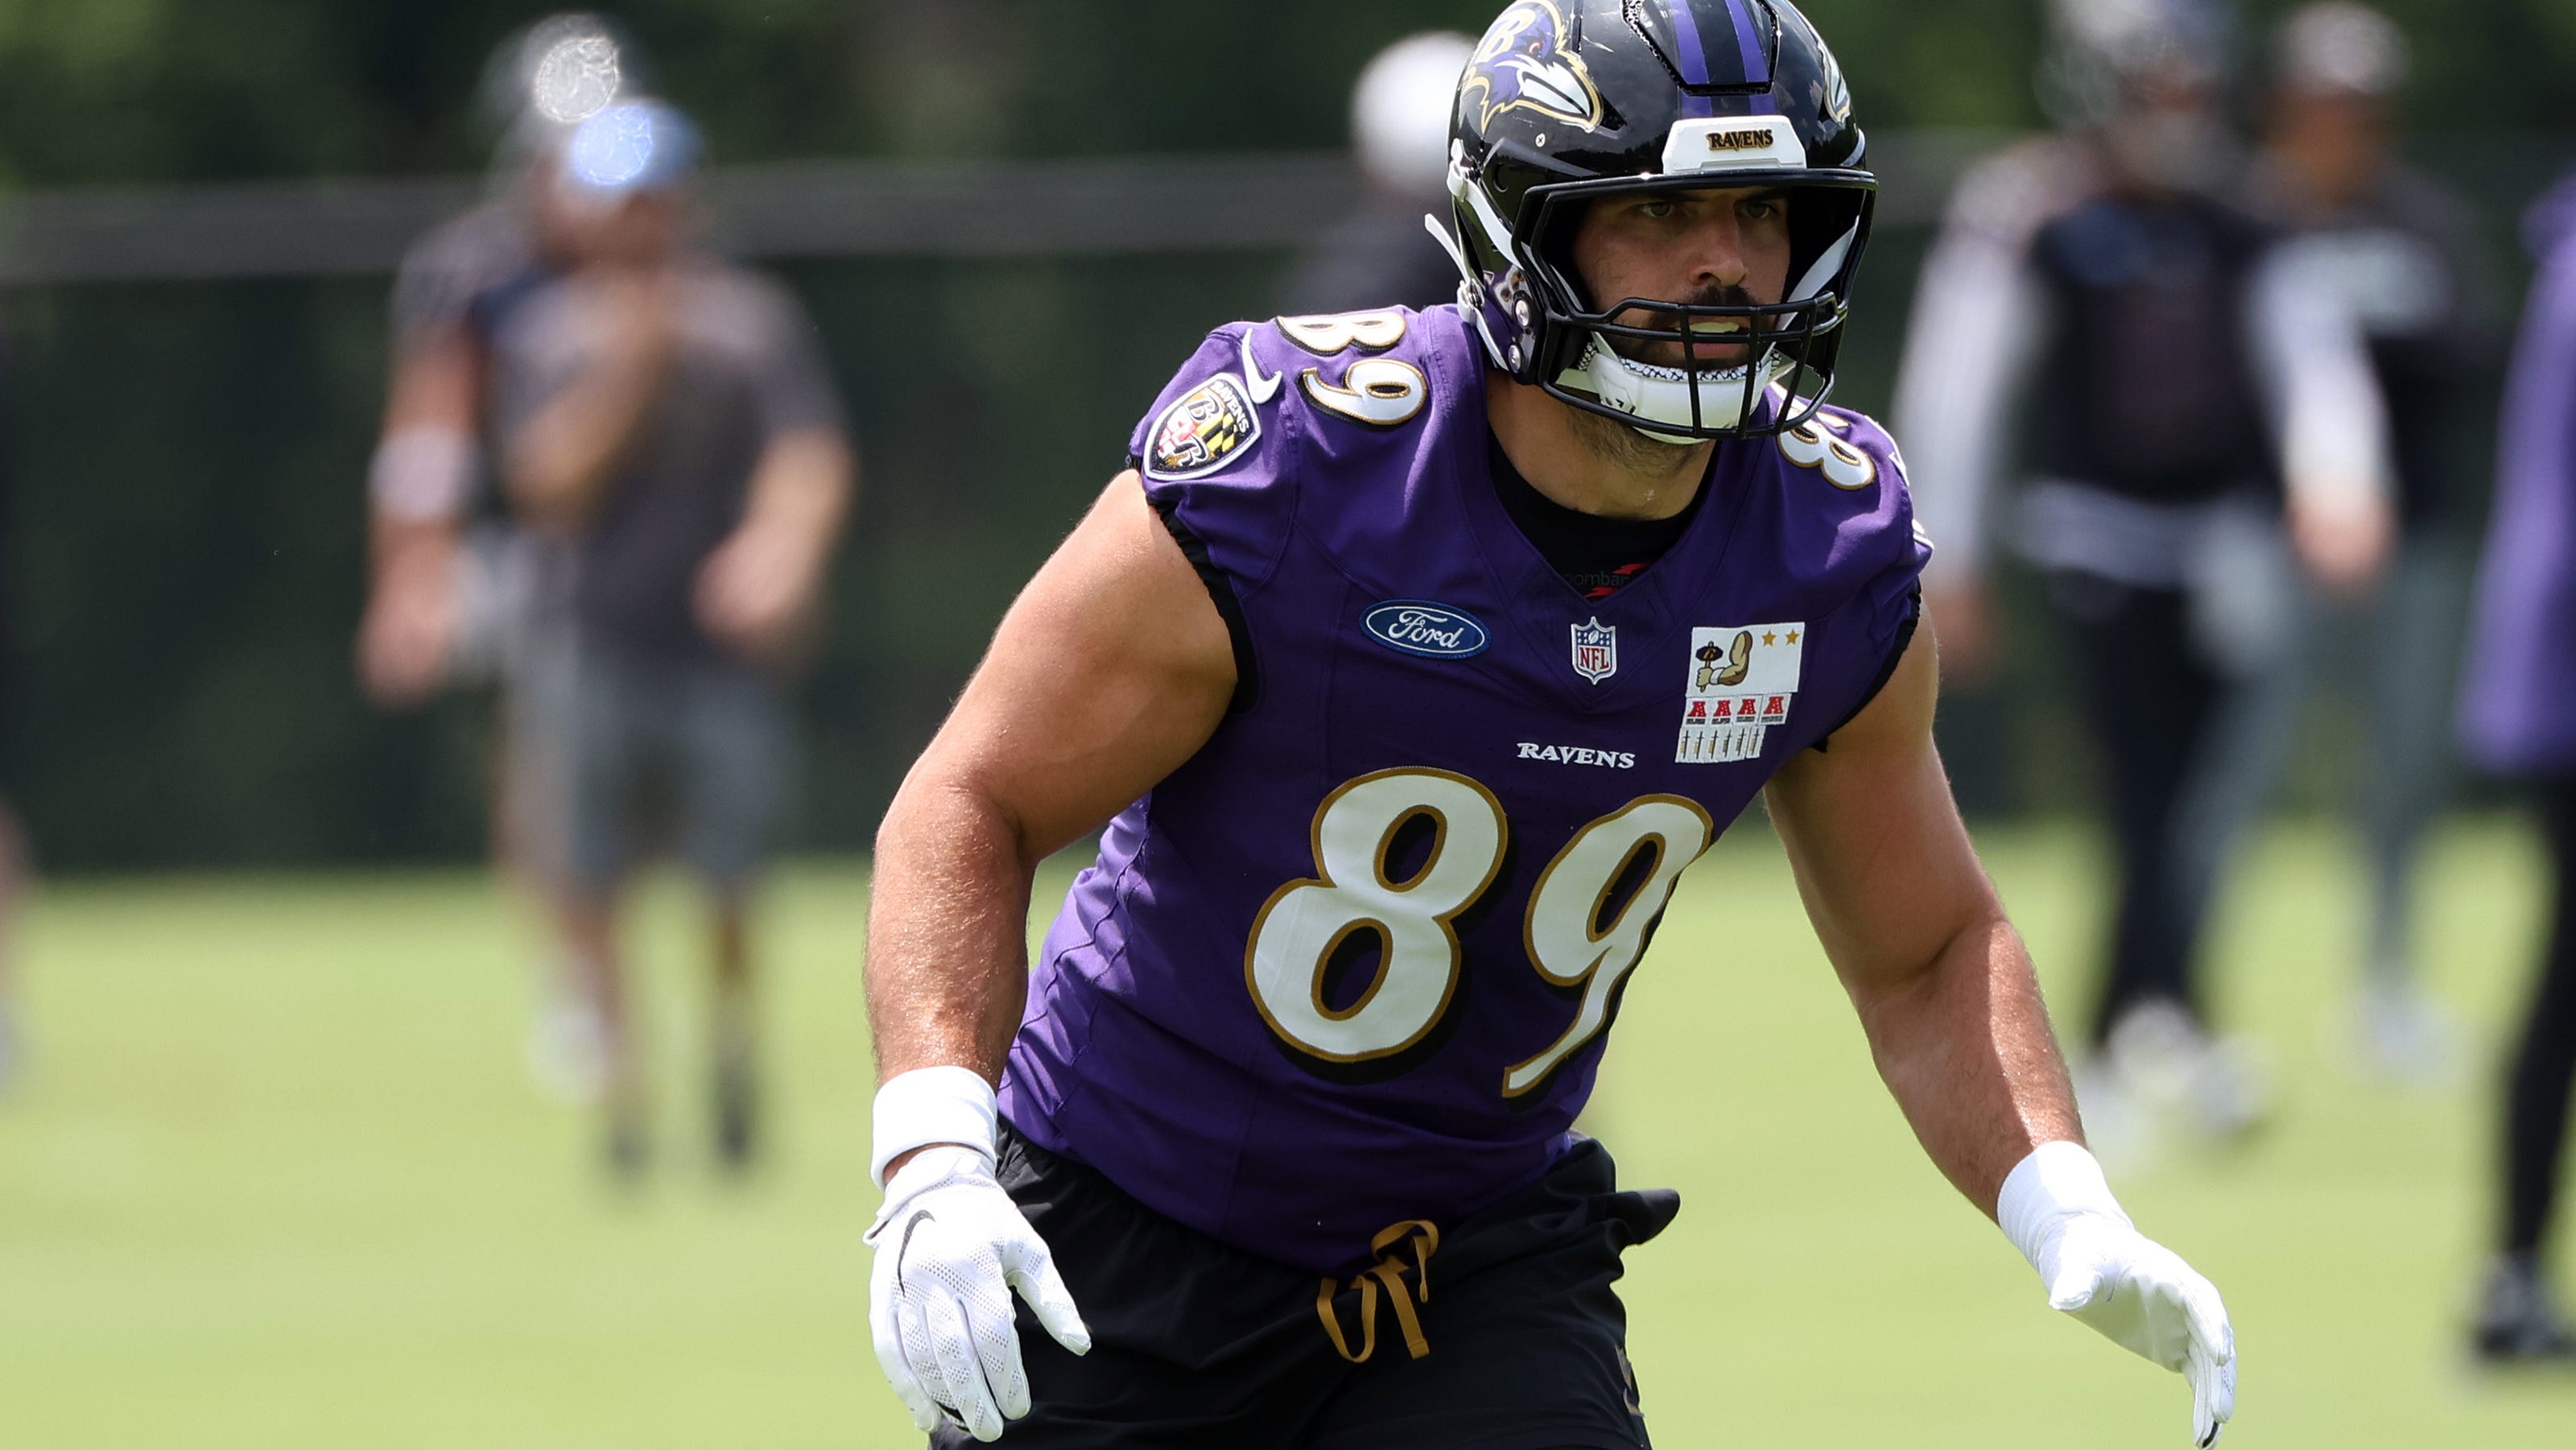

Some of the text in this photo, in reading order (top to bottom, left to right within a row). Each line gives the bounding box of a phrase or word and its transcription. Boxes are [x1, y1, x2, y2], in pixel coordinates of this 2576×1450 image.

[1705, 129, 1774, 151] RAVENS
[1208, 381, 1250, 434] RAVENS
[1388, 610, 1464, 649] Ford
[1578, 646, 1609, 671] NFL
[1516, 742, 1636, 770] RAVENS
[1244, 766, 1713, 1098] 89
